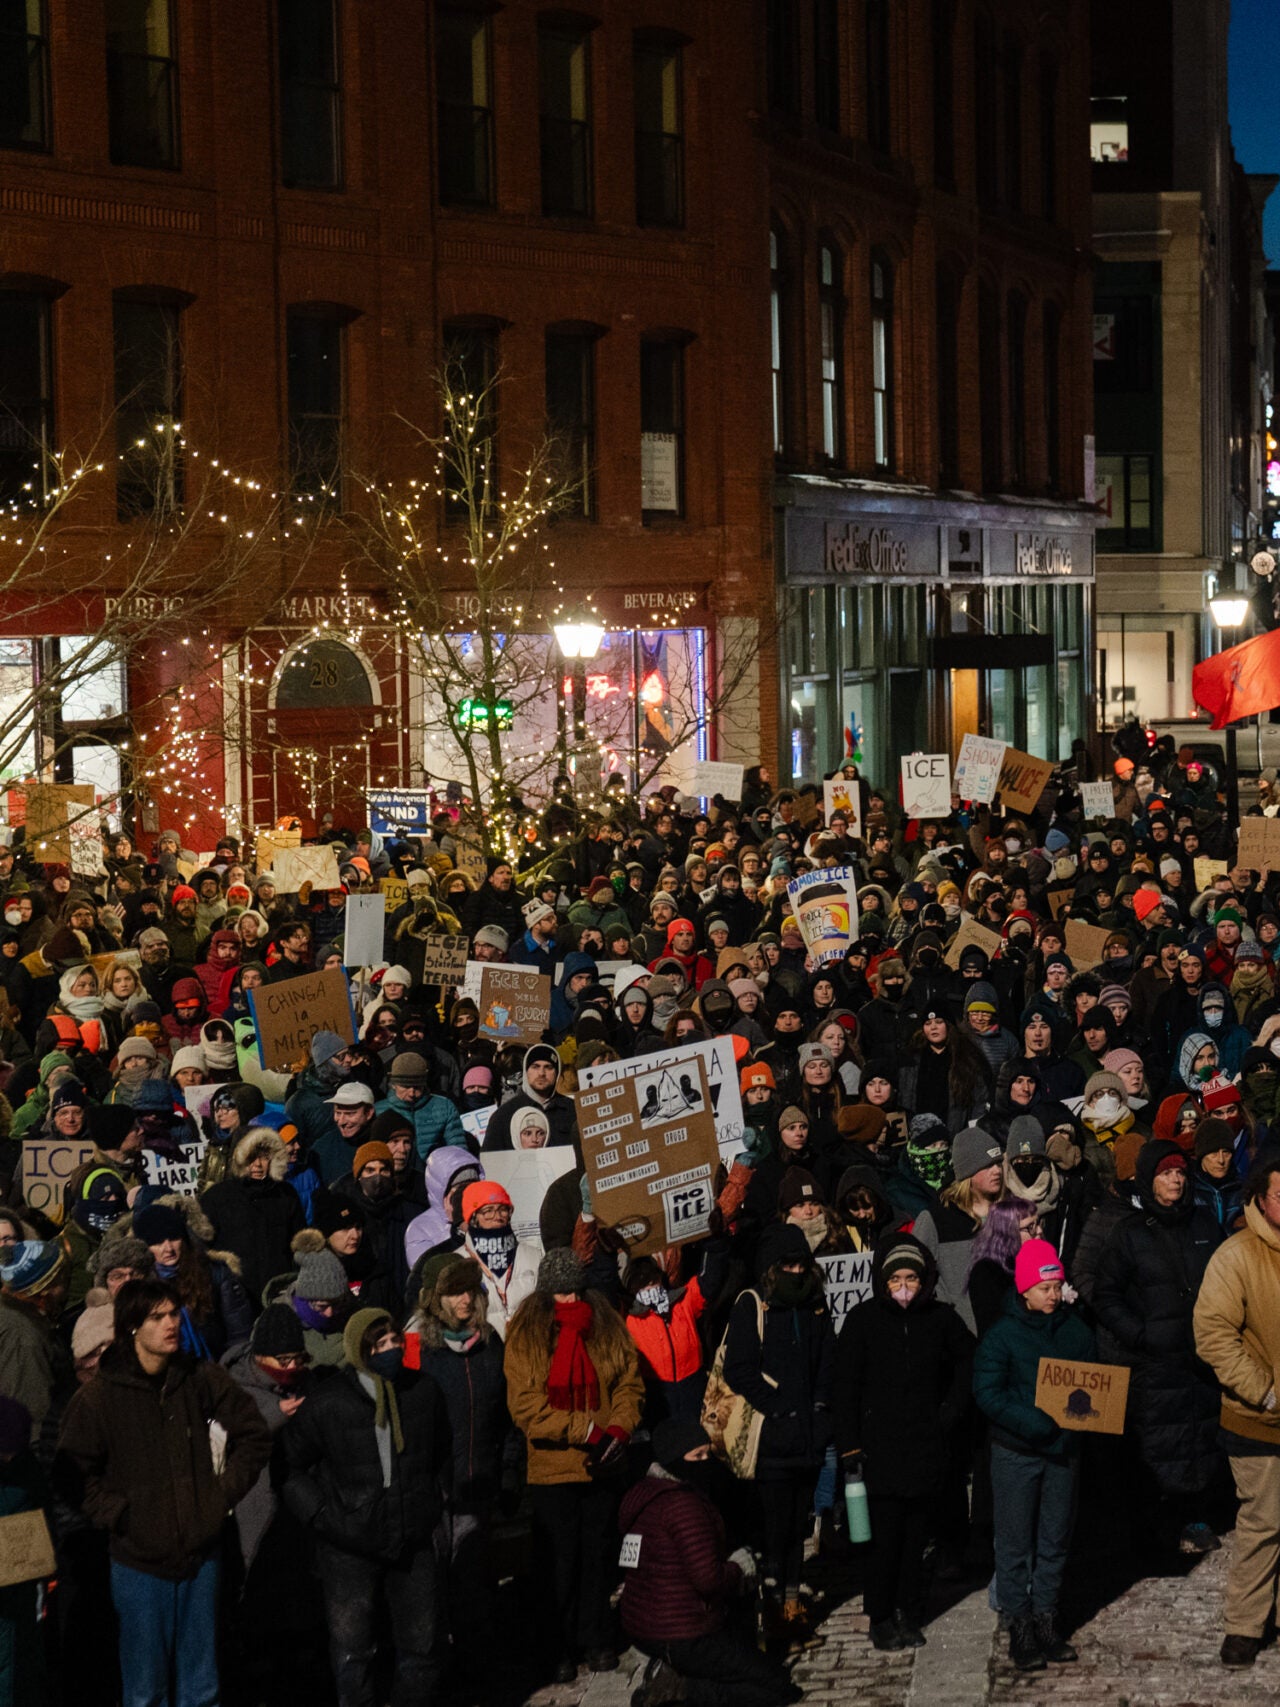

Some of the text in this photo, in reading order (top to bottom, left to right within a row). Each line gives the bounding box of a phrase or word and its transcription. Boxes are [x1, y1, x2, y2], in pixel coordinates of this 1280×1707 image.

[825, 522, 908, 573] FedEx Office
[1016, 533, 1073, 575] FedEx Office
[105, 597, 184, 619] PUBLIC
[280, 596, 370, 618] MARKET
[624, 592, 697, 609] BEVERAGES
[310, 659, 338, 688] 28
[963, 747, 1001, 767] SHOW
[906, 758, 945, 779] ICE
[788, 866, 850, 895] NO MORE ICE
[427, 935, 469, 951] ICE
[489, 971, 521, 989] ICE
[267, 979, 326, 1015] CHINGA
[294, 1010, 308, 1023] la
[516, 1005, 549, 1022] BURN
[582, 1086, 623, 1106] JUST LIKE
[460, 1110, 489, 1130] CE
[598, 1106, 612, 1117] THE
[600, 1122, 608, 1130] ON
[610, 1116, 632, 1129] DRUGS
[597, 1129, 686, 1167] NEVER ABOUT DRUGS
[157, 1167, 202, 1186] HARA
[597, 1164, 658, 1191] TARGETING IMMIGRANTS
[655, 1181, 664, 1190] NOT
[665, 1175, 683, 1188] ABOUT
[683, 1166, 709, 1182] CRIMINALS
[673, 1187, 704, 1204] NO
[473, 1236, 515, 1253] ABOLISH
[487, 1253, 508, 1270] ICE
[826, 1260, 847, 1284] KE
[828, 1287, 870, 1315] KEY
[1041, 1363, 1112, 1393] ABOLISH
